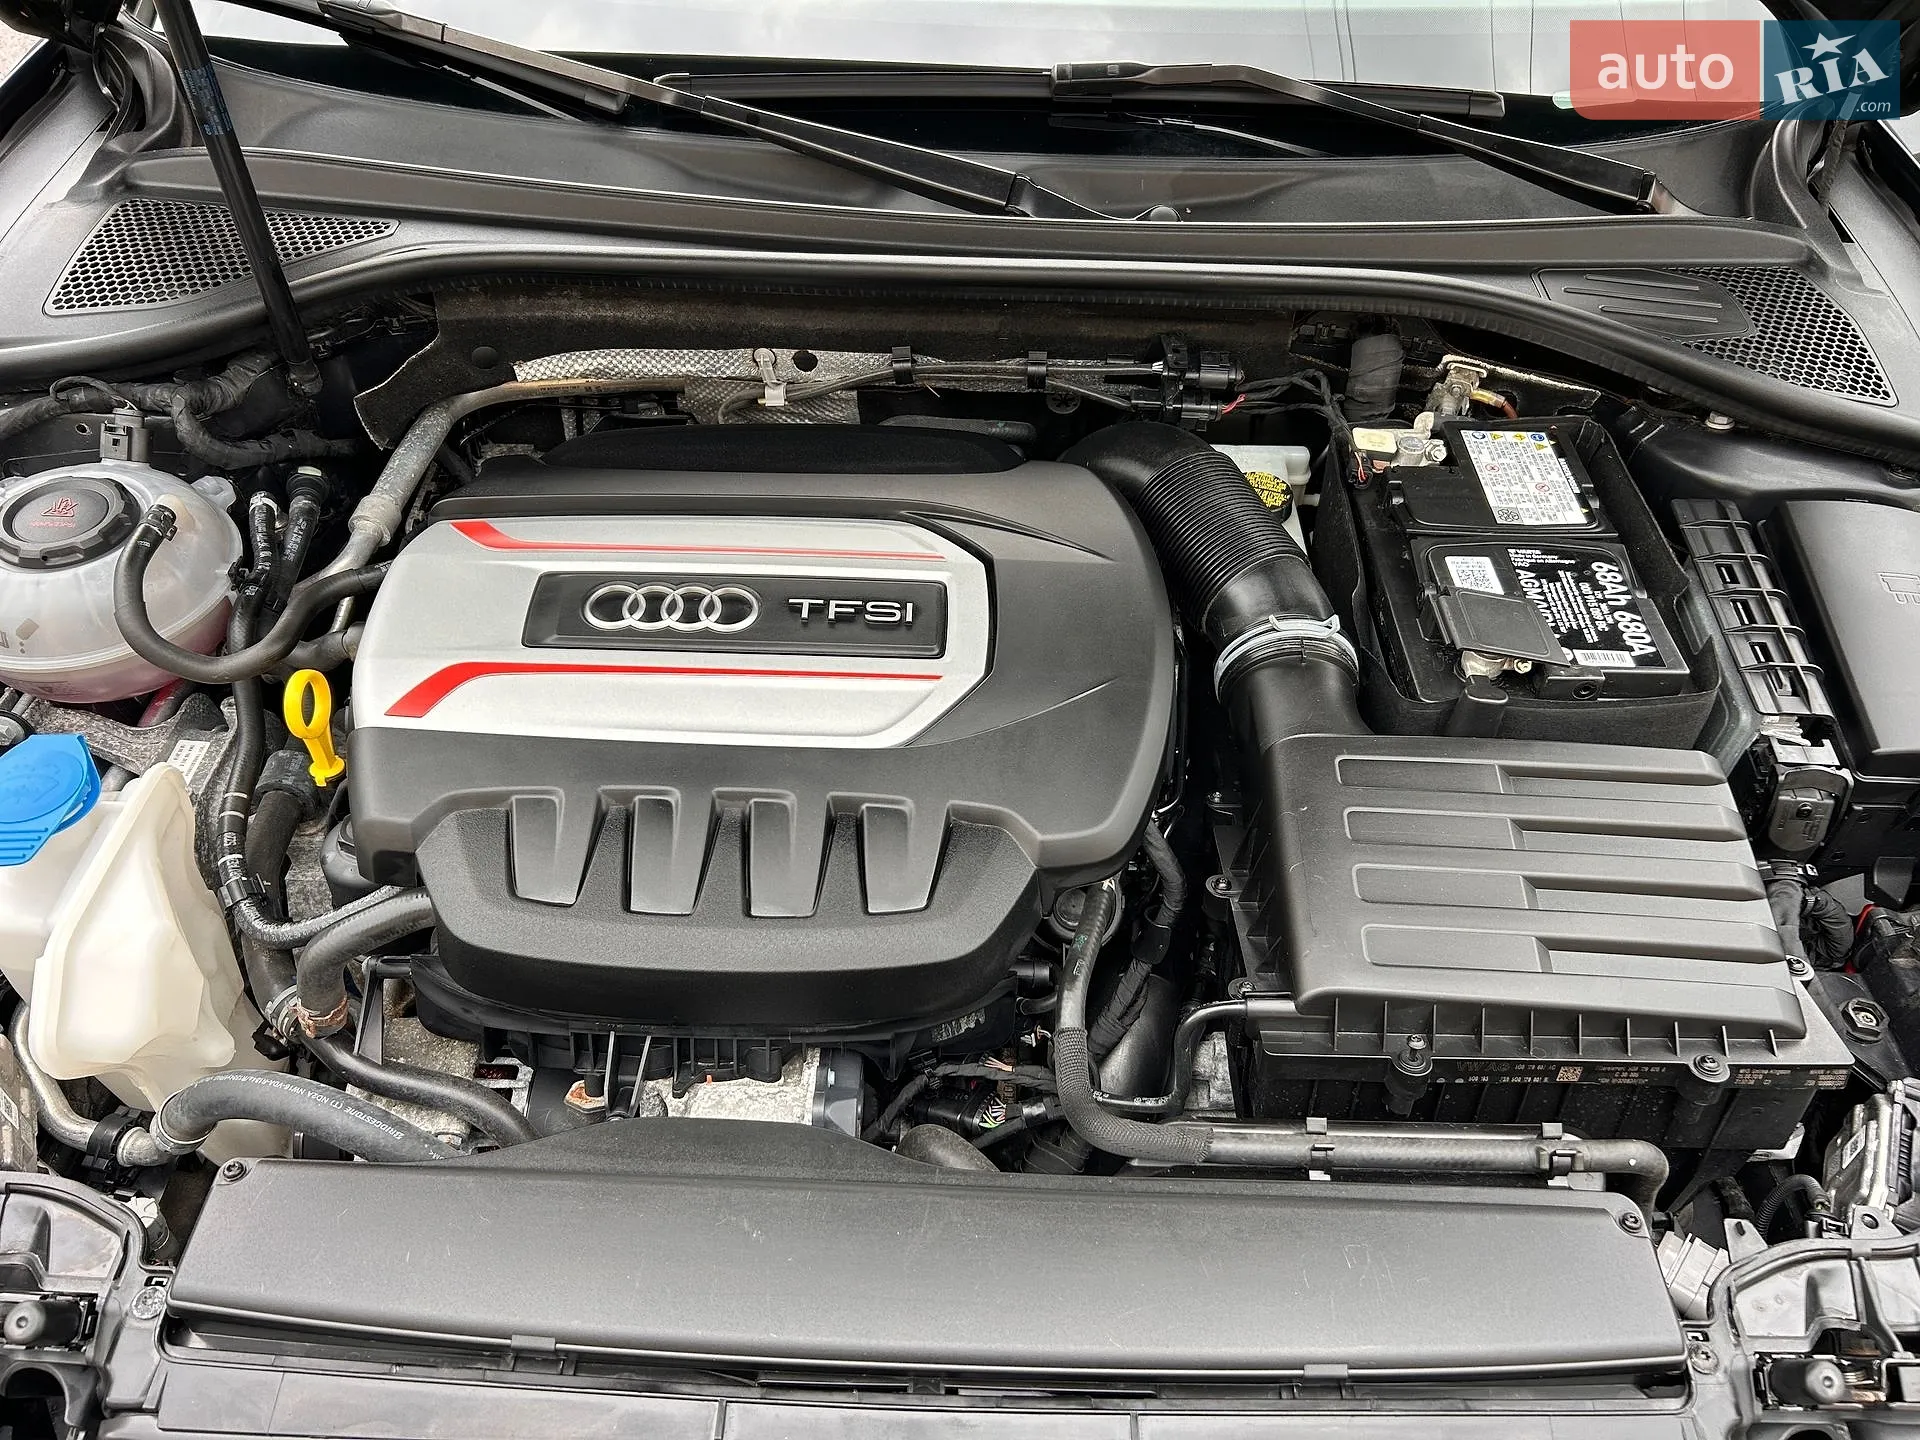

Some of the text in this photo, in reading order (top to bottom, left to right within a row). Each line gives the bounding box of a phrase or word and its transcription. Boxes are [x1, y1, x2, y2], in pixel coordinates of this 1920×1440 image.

[788, 598, 914, 625] TFSI
[1591, 562, 1631, 606] 68Ah
[1613, 611, 1656, 657] 680A
[307, 1091, 330, 1104] ND2A
[329, 1099, 343, 1109] (T)
[344, 1106, 404, 1140] BRIDGESTONE
